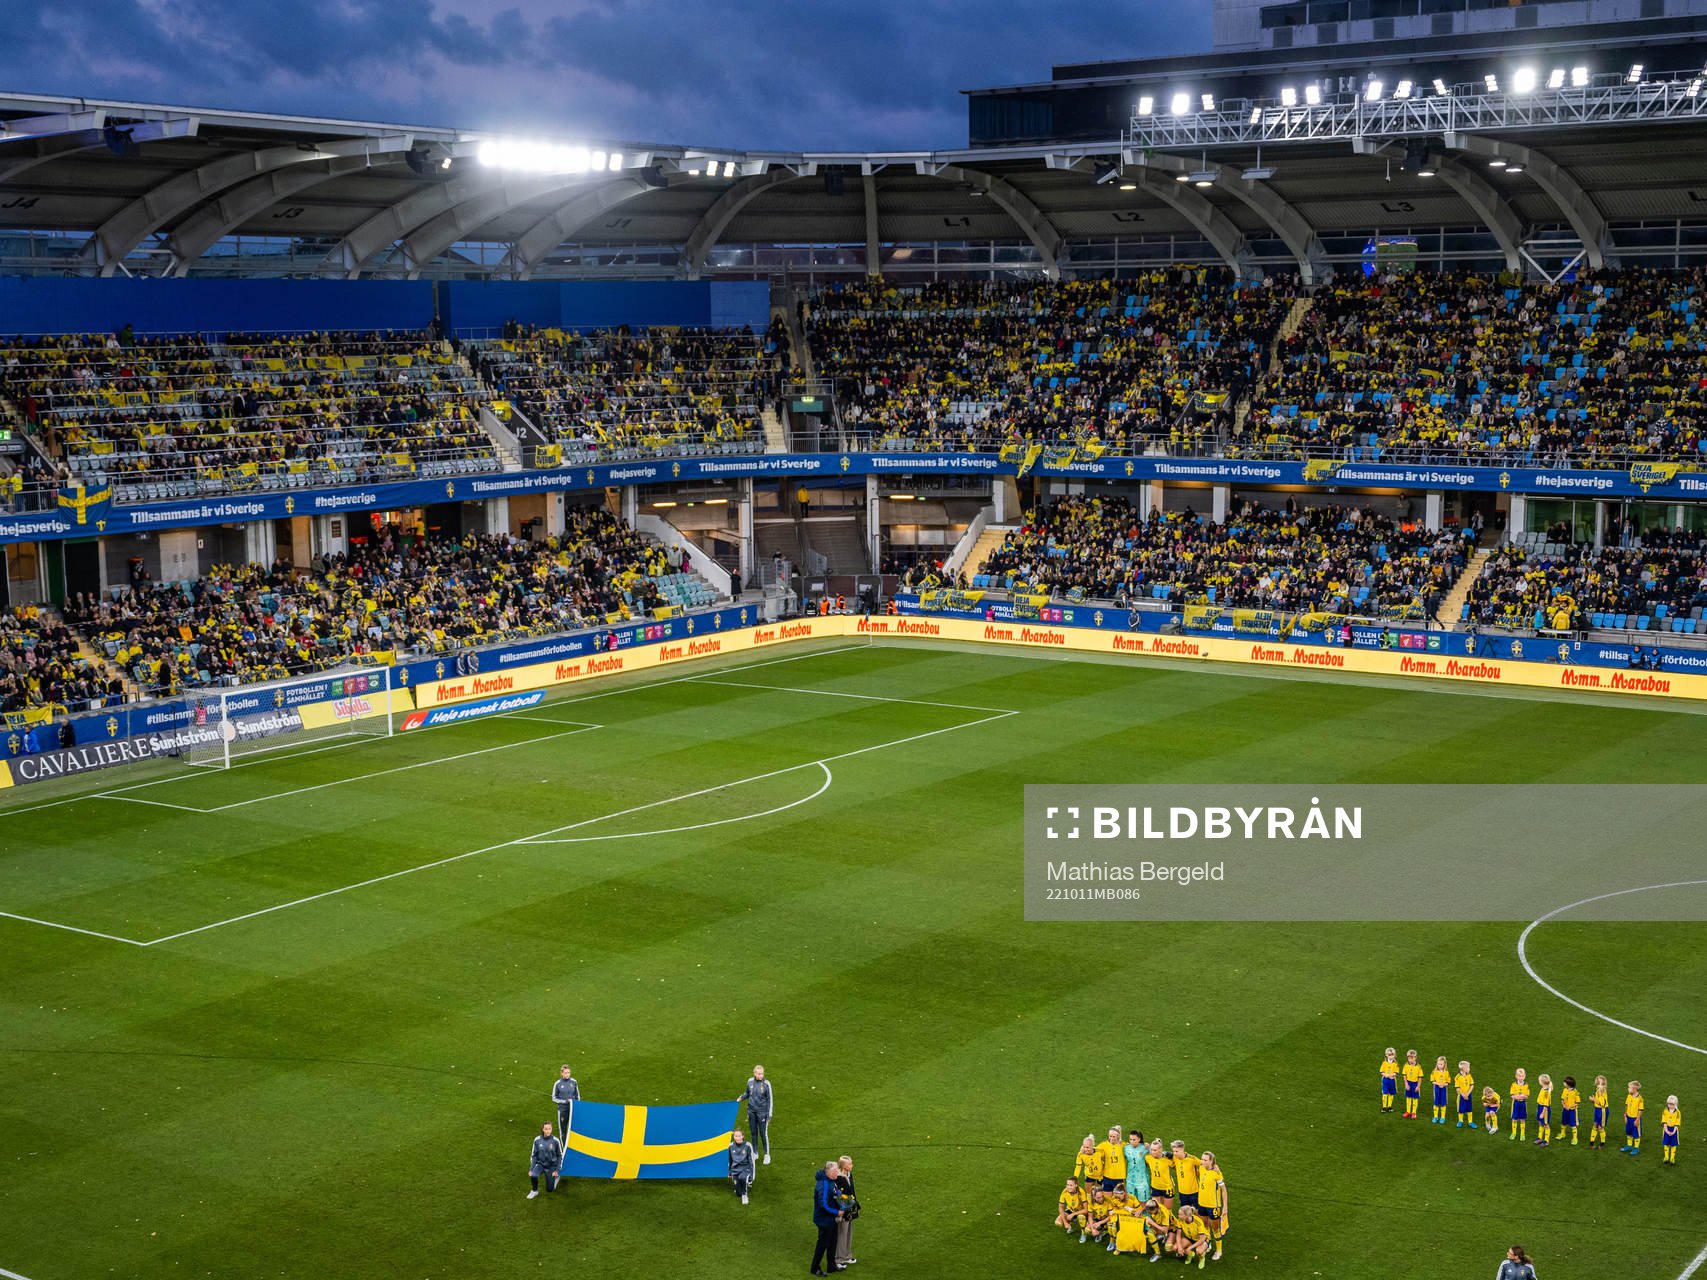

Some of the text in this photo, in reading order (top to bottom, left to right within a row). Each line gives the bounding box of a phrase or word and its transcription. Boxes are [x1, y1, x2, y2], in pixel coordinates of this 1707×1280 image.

[2, 197, 39, 209] J4
[1381, 201, 1416, 213] L3
[272, 207, 305, 218] J3
[1112, 212, 1145, 222] L2
[944, 217, 970, 226] L1
[516, 427, 527, 438] J2
[28, 456, 41, 469] J4
[699, 459, 820, 472] Tillsammans är vi Sverige
[872, 458, 997, 469] Tillsammans är vi Sverige
[1633, 464, 1652, 472] HEJA
[610, 466, 656, 480] #hejasverige
[1155, 463, 1281, 478] Tillsammans är vi Sverige
[1336, 469, 1404, 481] Tillsammans
[1405, 471, 1417, 481] är
[1419, 472, 1430, 482] vi
[1431, 472, 1474, 484] Sverige
[1631, 470, 1666, 479] SVERIGE!
[472, 474, 571, 492] Tillsammans är vi Sverige
[1536, 475, 1613, 489] #hejasverige
[315, 492, 376, 508] #hejasverige
[131, 502, 264, 523] Tillsammans är vi Sverige
[1016, 596, 1029, 604] HEJA
[500, 642, 582, 664] #tillsammansförfotbollen
[286, 685, 325, 697] FOTBOLLEN
[286, 690, 324, 704] SAMHÄLLET
[333, 699, 371, 719] Sibylla
[430, 710, 458, 724] Heja
[458, 702, 498, 718] svensk
[236, 711, 300, 734] Sundström
[150, 726, 220, 751] Sundström
[19, 738, 150, 780] CAVALIERE
